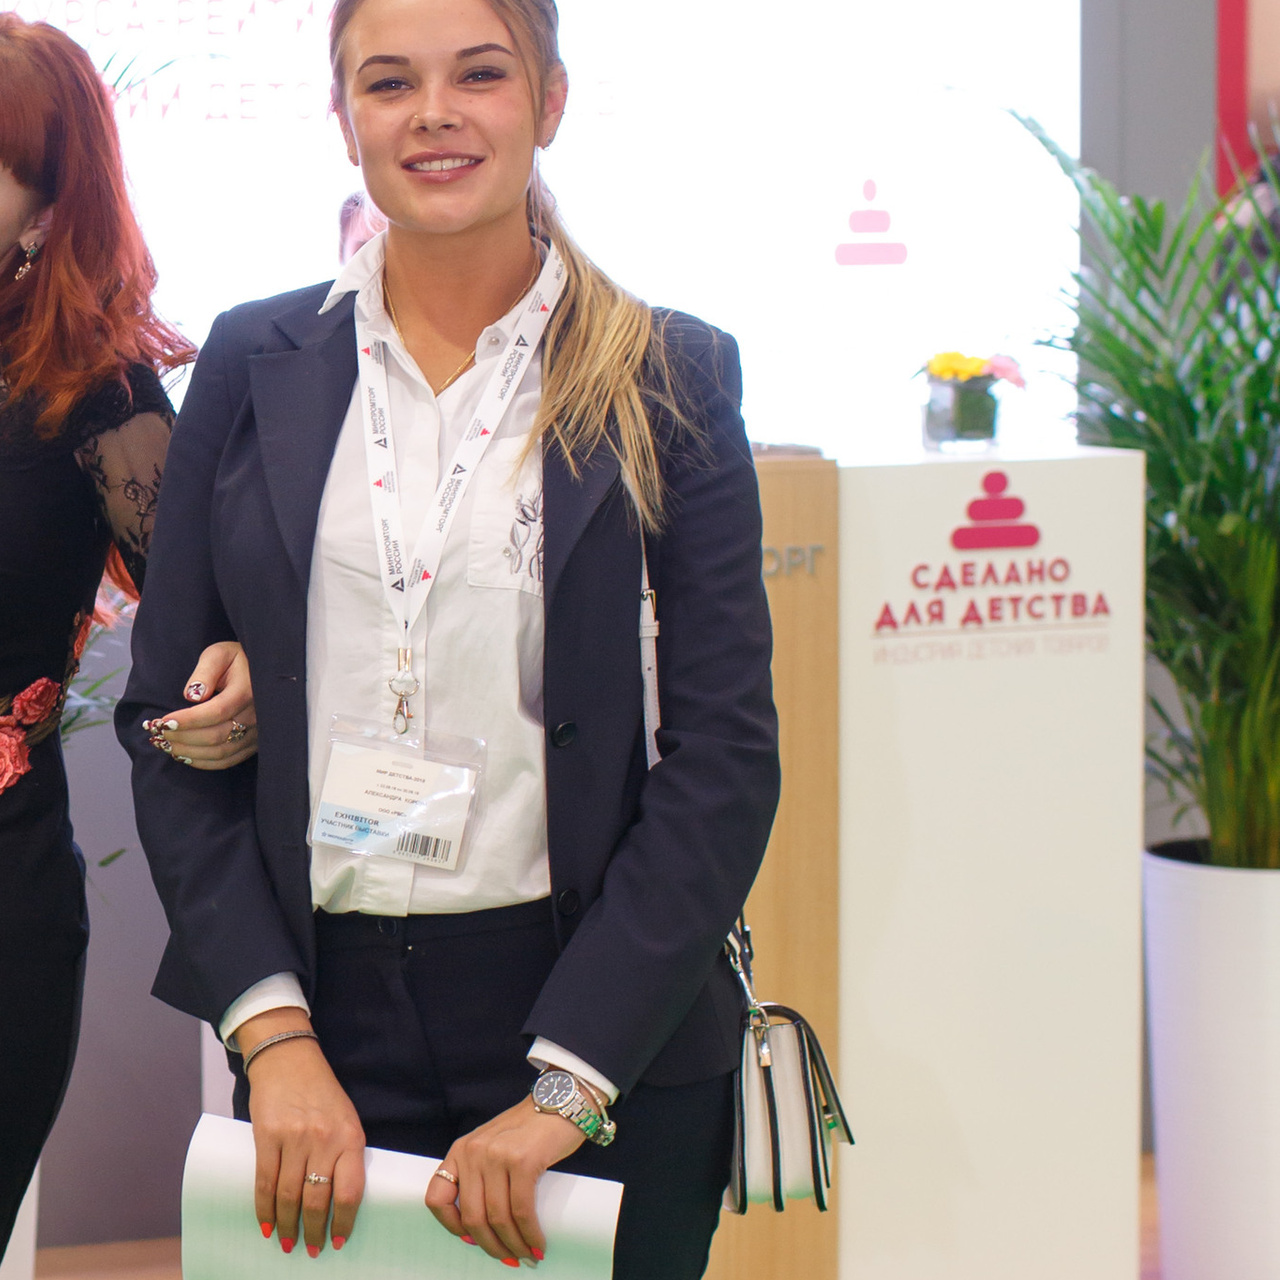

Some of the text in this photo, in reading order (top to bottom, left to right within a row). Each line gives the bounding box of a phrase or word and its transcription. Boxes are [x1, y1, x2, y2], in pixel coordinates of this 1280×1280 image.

[910, 557, 1070, 592] СДЕЛАНО
[874, 593, 1112, 632] ДЛЯ ДЕТСТВА
[321, 818, 353, 830] УЧАСТНИК
[334, 811, 380, 826] EXHIBITOR
